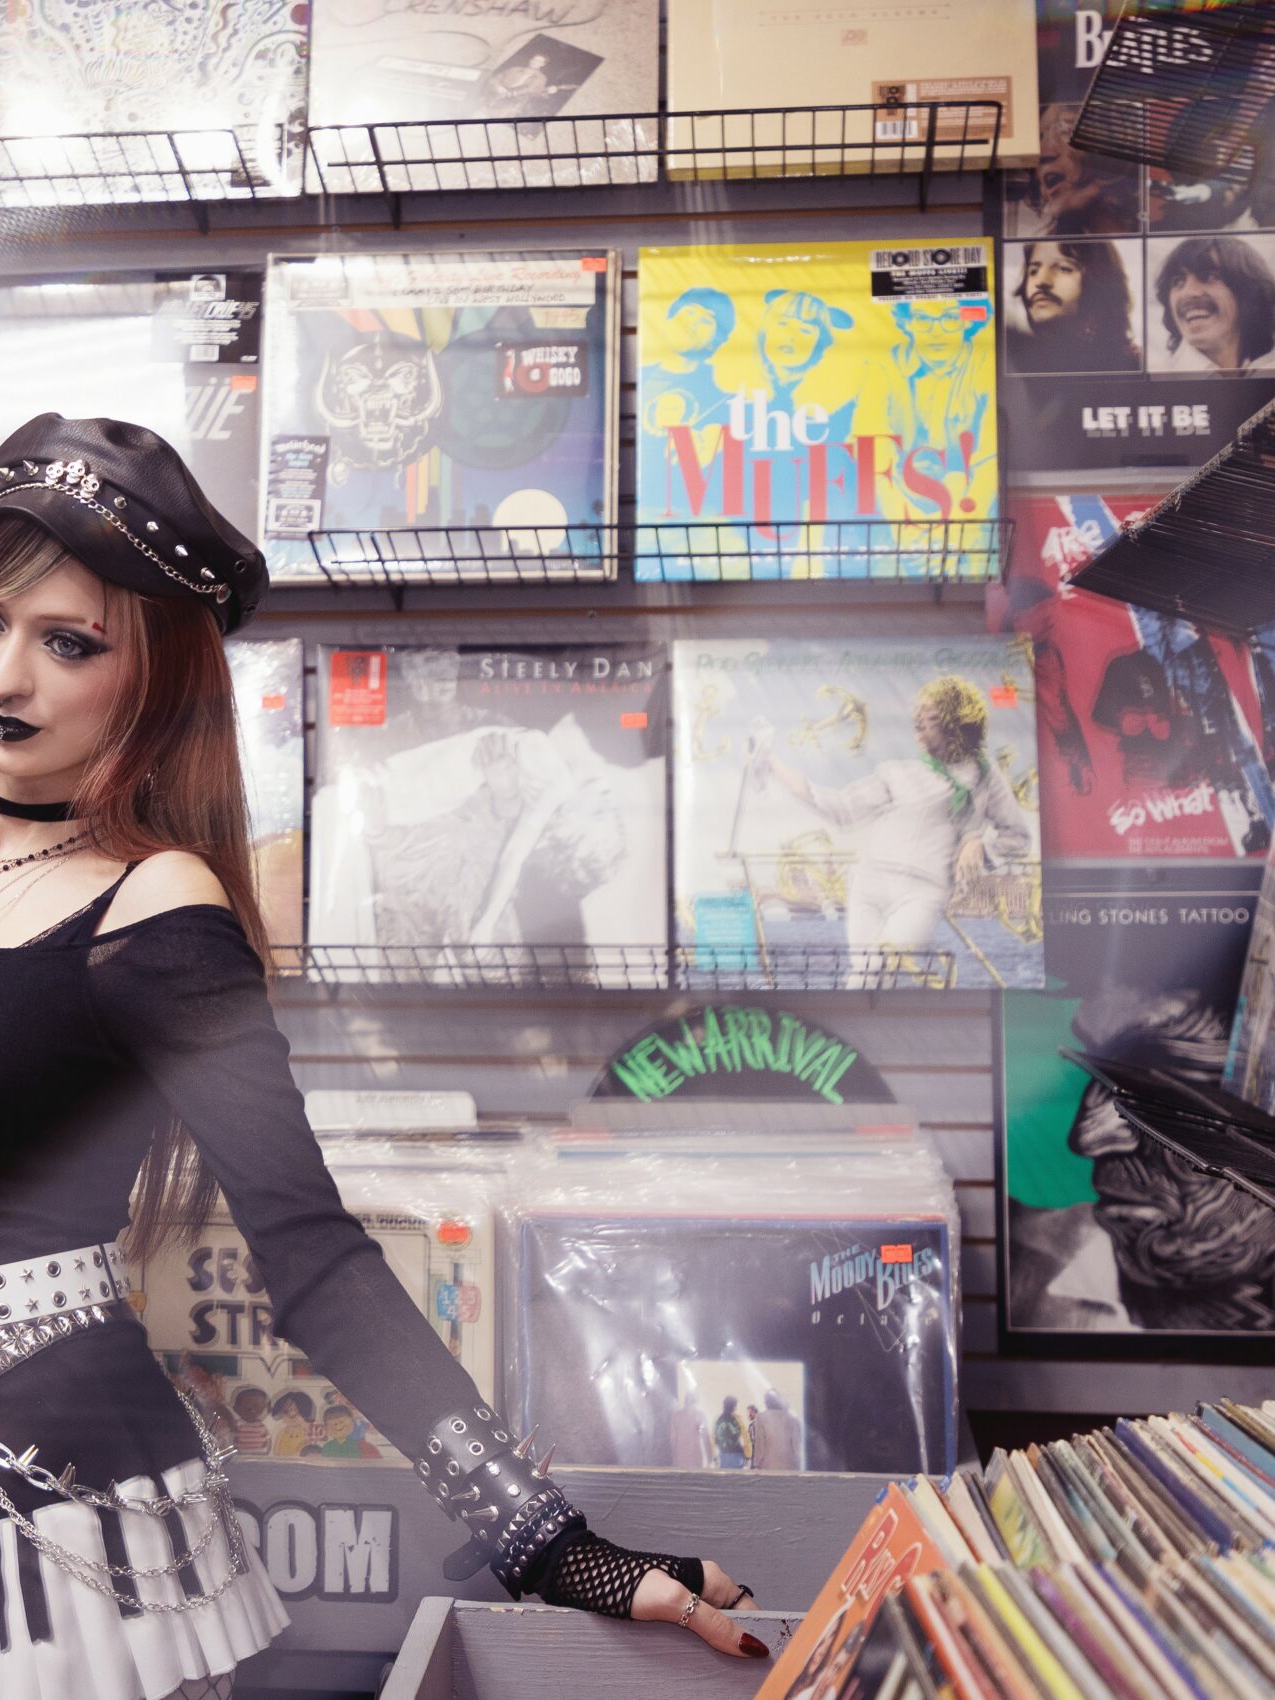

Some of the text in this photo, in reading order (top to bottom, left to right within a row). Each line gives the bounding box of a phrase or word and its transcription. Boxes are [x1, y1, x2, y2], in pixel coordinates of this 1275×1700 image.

[876, 246, 982, 269] RECORD STORE DAY
[521, 345, 579, 366] WHISKY
[727, 388, 830, 452] the
[1081, 403, 1211, 432] LET IT BE
[660, 425, 979, 542] MUFFS!
[479, 655, 654, 680] STEELY DAN
[570, 681, 654, 694] AMERICA
[1143, 782, 1216, 823] What
[1098, 906, 1169, 926] STONES
[1179, 906, 1250, 926] TATTOO
[612, 1005, 858, 1104] NEW ARRIVAL
[831, 1243, 862, 1265] THE
[809, 1247, 877, 1306] MOODY
